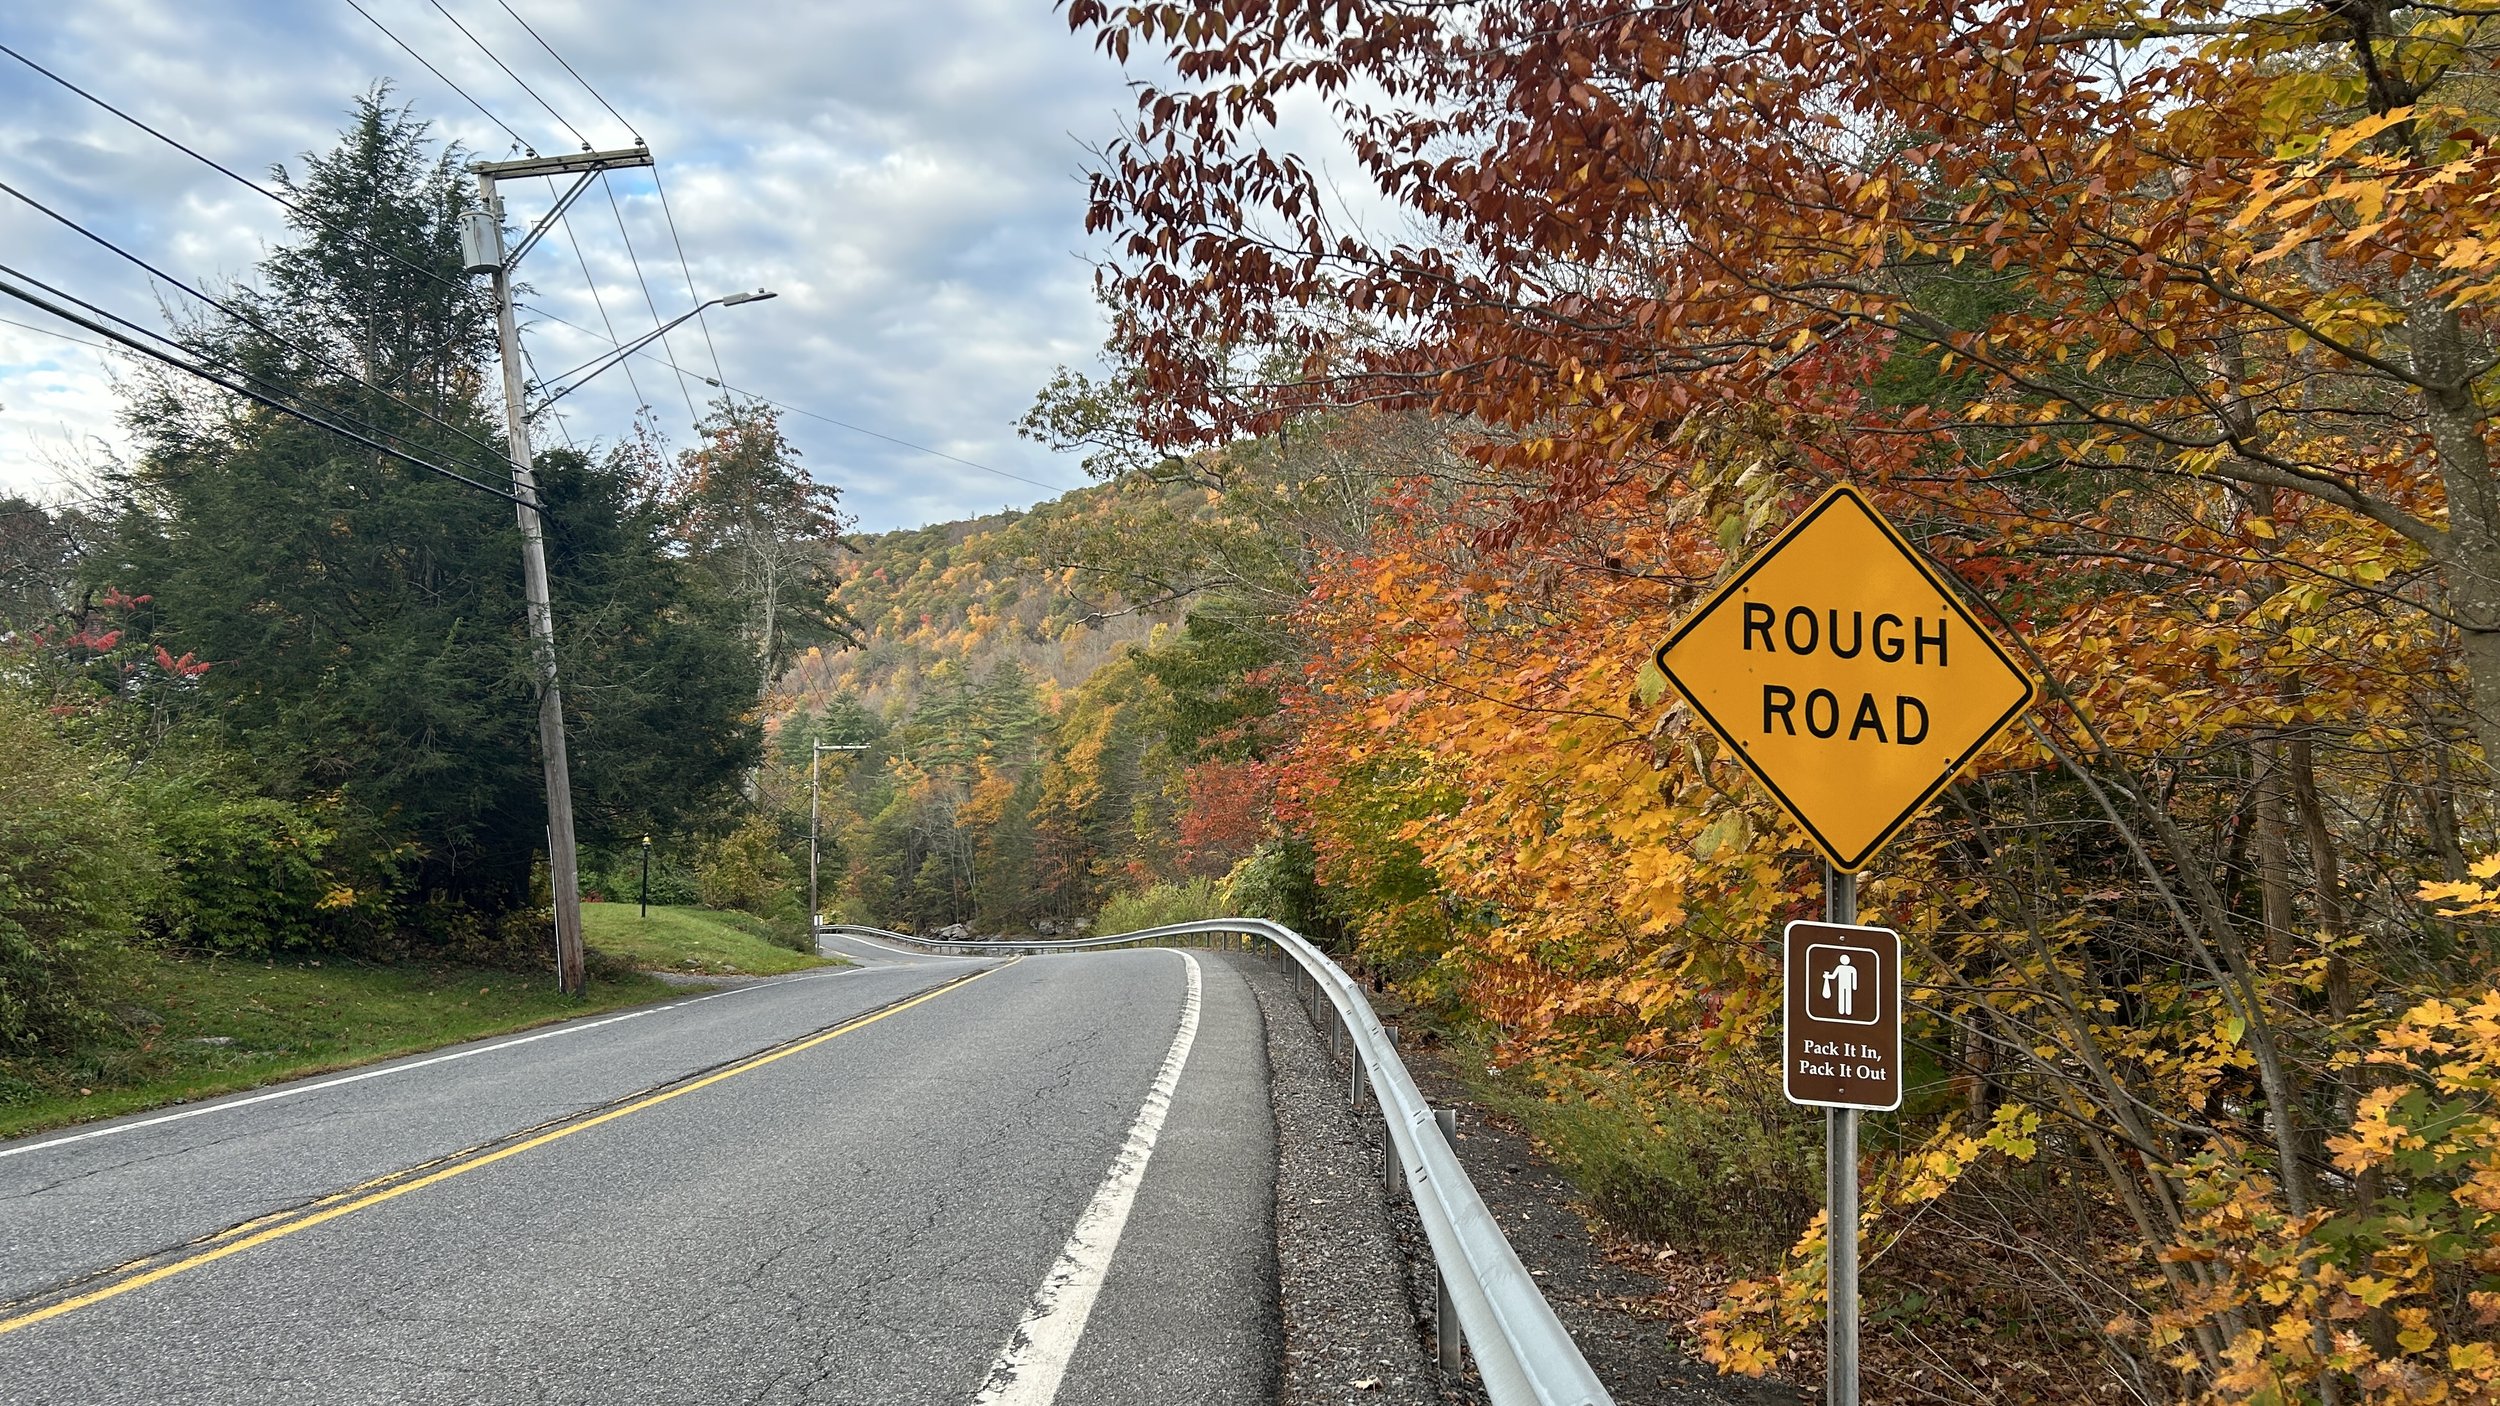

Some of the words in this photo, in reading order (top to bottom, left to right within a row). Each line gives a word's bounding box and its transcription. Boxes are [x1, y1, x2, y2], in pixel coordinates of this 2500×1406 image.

[1742, 601, 1948, 667] ROUGH
[1762, 684, 1931, 746] ROAD
[1799, 1060, 1835, 1077] Pack
[1839, 1063, 1852, 1078] It
[1856, 1065, 1887, 1081] Out
[1803, 1039, 1840, 1056] Pack
[1844, 1042, 1857, 1058] It
[1860, 1044, 1882, 1062] In,
